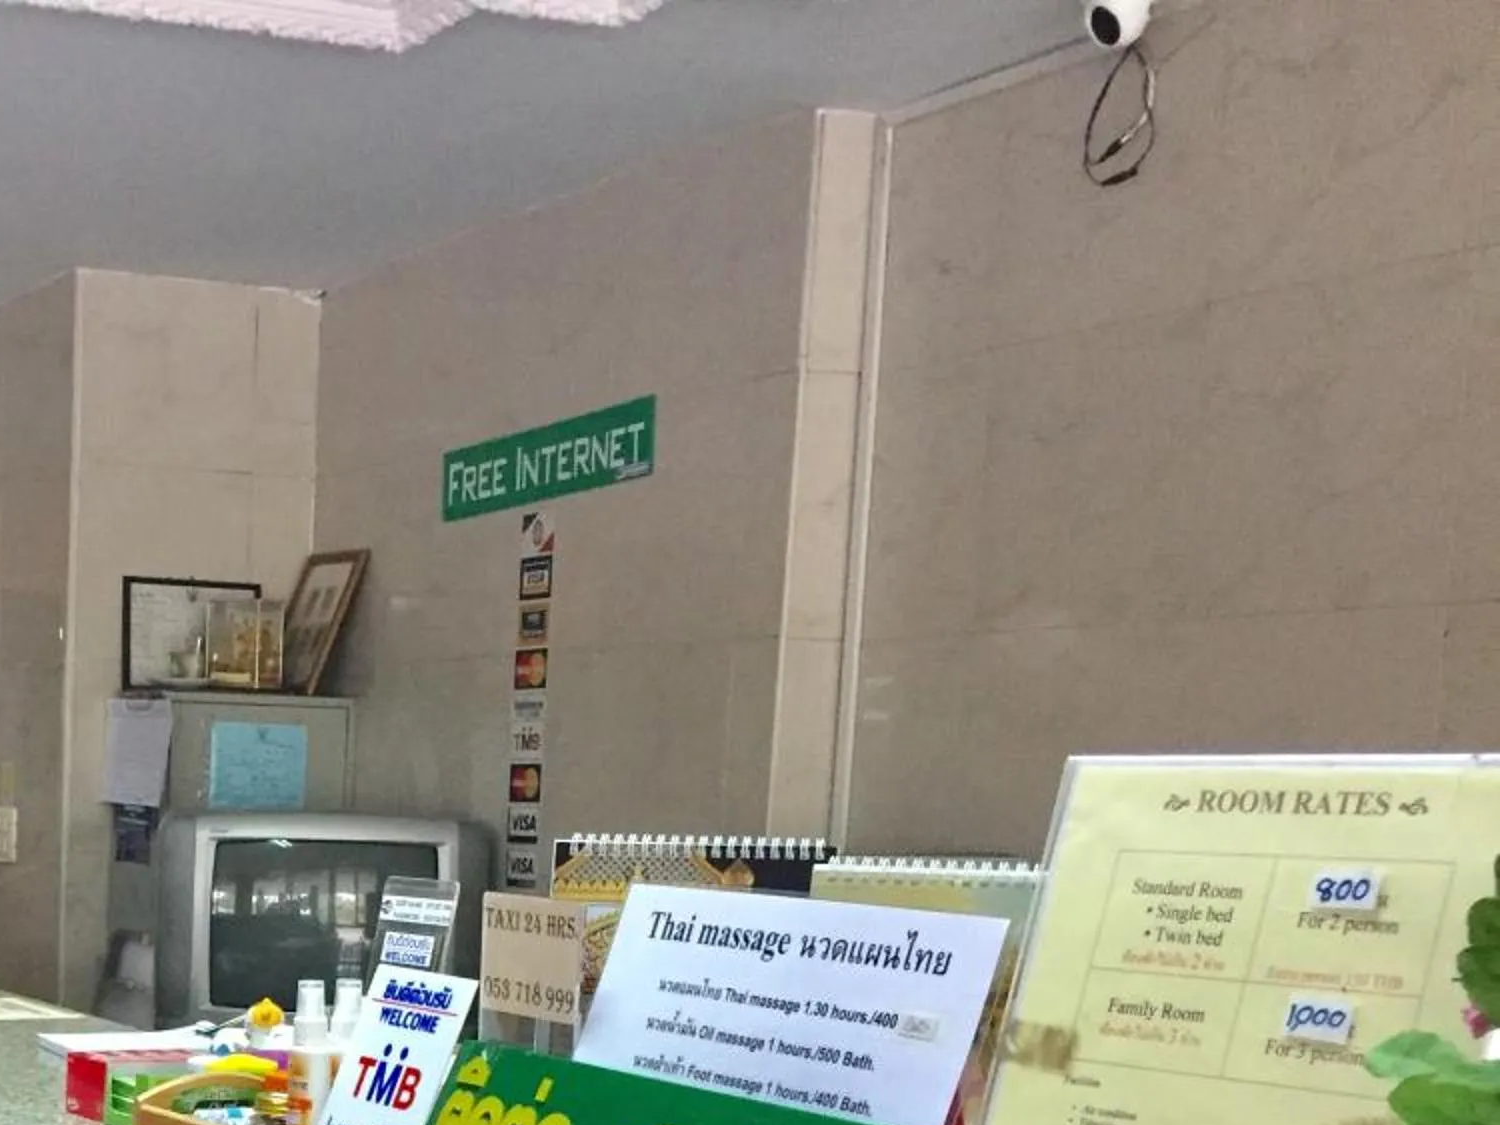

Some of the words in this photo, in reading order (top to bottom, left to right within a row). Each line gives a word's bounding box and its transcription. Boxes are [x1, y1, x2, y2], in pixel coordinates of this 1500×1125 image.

[1196, 789, 1286, 815] ROOM
[1292, 790, 1393, 816] RATES
[513, 815, 537, 831] VISA
[511, 858, 534, 874] VISA
[1131, 876, 1197, 899] Standard
[1199, 882, 1244, 901] Room
[1315, 877, 1372, 902] 800
[486, 907, 521, 933] TAXI
[524, 912, 542, 934] 24
[1155, 903, 1202, 924] Single
[1204, 906, 1235, 924] bed
[1297, 911, 1324, 930] For
[1326, 913, 1340, 930] 2
[1342, 917, 1400, 936] person
[648, 911, 697, 942] Thai
[698, 924, 791, 963] massage
[799, 929, 953, 977] นวดแผนไทย
[1155, 926, 1192, 947] Twin
[1194, 929, 1224, 948] bed
[515, 980, 544, 1006] 718
[545, 987, 575, 1014] 999
[725, 987, 749, 1004] Thai
[749, 994, 801, 1015] massage
[803, 1001, 830, 1017] 1.30
[379, 1006, 441, 1034] WELCOME
[1107, 998, 1157, 1020] Family
[1160, 1004, 1206, 1023] Room
[699, 1023, 716, 1041] Oil
[715, 1028, 765, 1053] massage
[1265, 1038, 1292, 1057] For
[353, 1044, 422, 1111] TMB
[686, 1064, 713, 1083] Foot
[713, 1072, 764, 1095] massage
